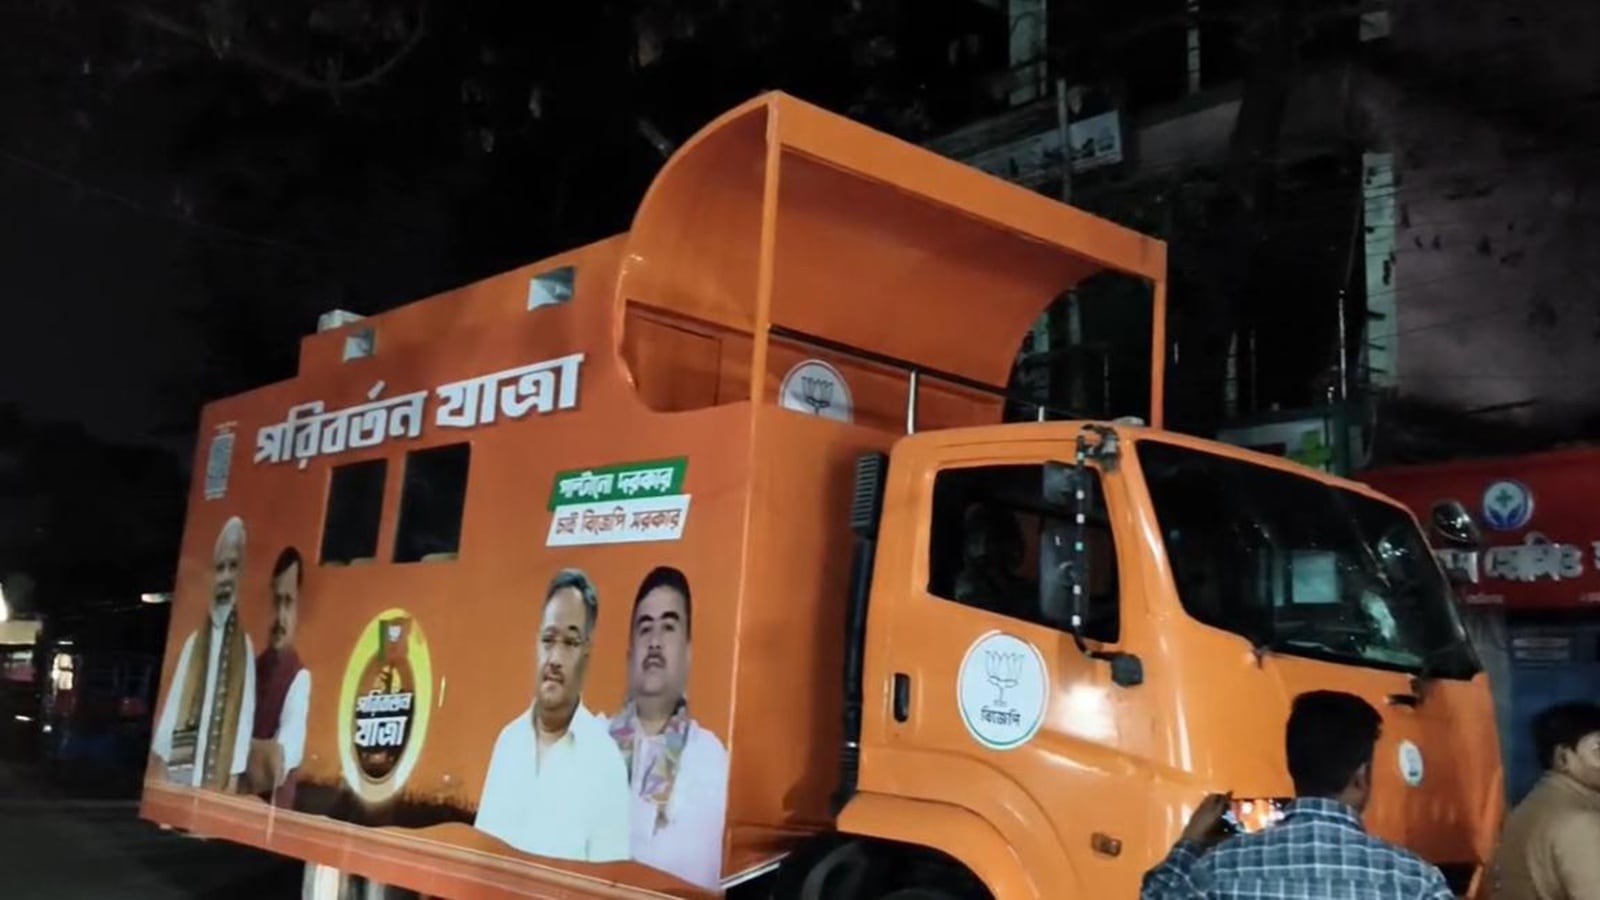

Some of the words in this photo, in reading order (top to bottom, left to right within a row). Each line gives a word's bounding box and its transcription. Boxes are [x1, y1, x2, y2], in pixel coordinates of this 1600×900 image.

[254, 380, 428, 470] পরিবর্তন
[435, 352, 585, 427] যাত্রা
[617, 467, 675, 495] দরকার
[555, 511, 580, 535] চাই
[582, 505, 627, 535] বিজেপি
[630, 508, 682, 532] সরকার
[981, 705, 1021, 726] বিজেপি
[355, 717, 407, 746] যাত্রা
